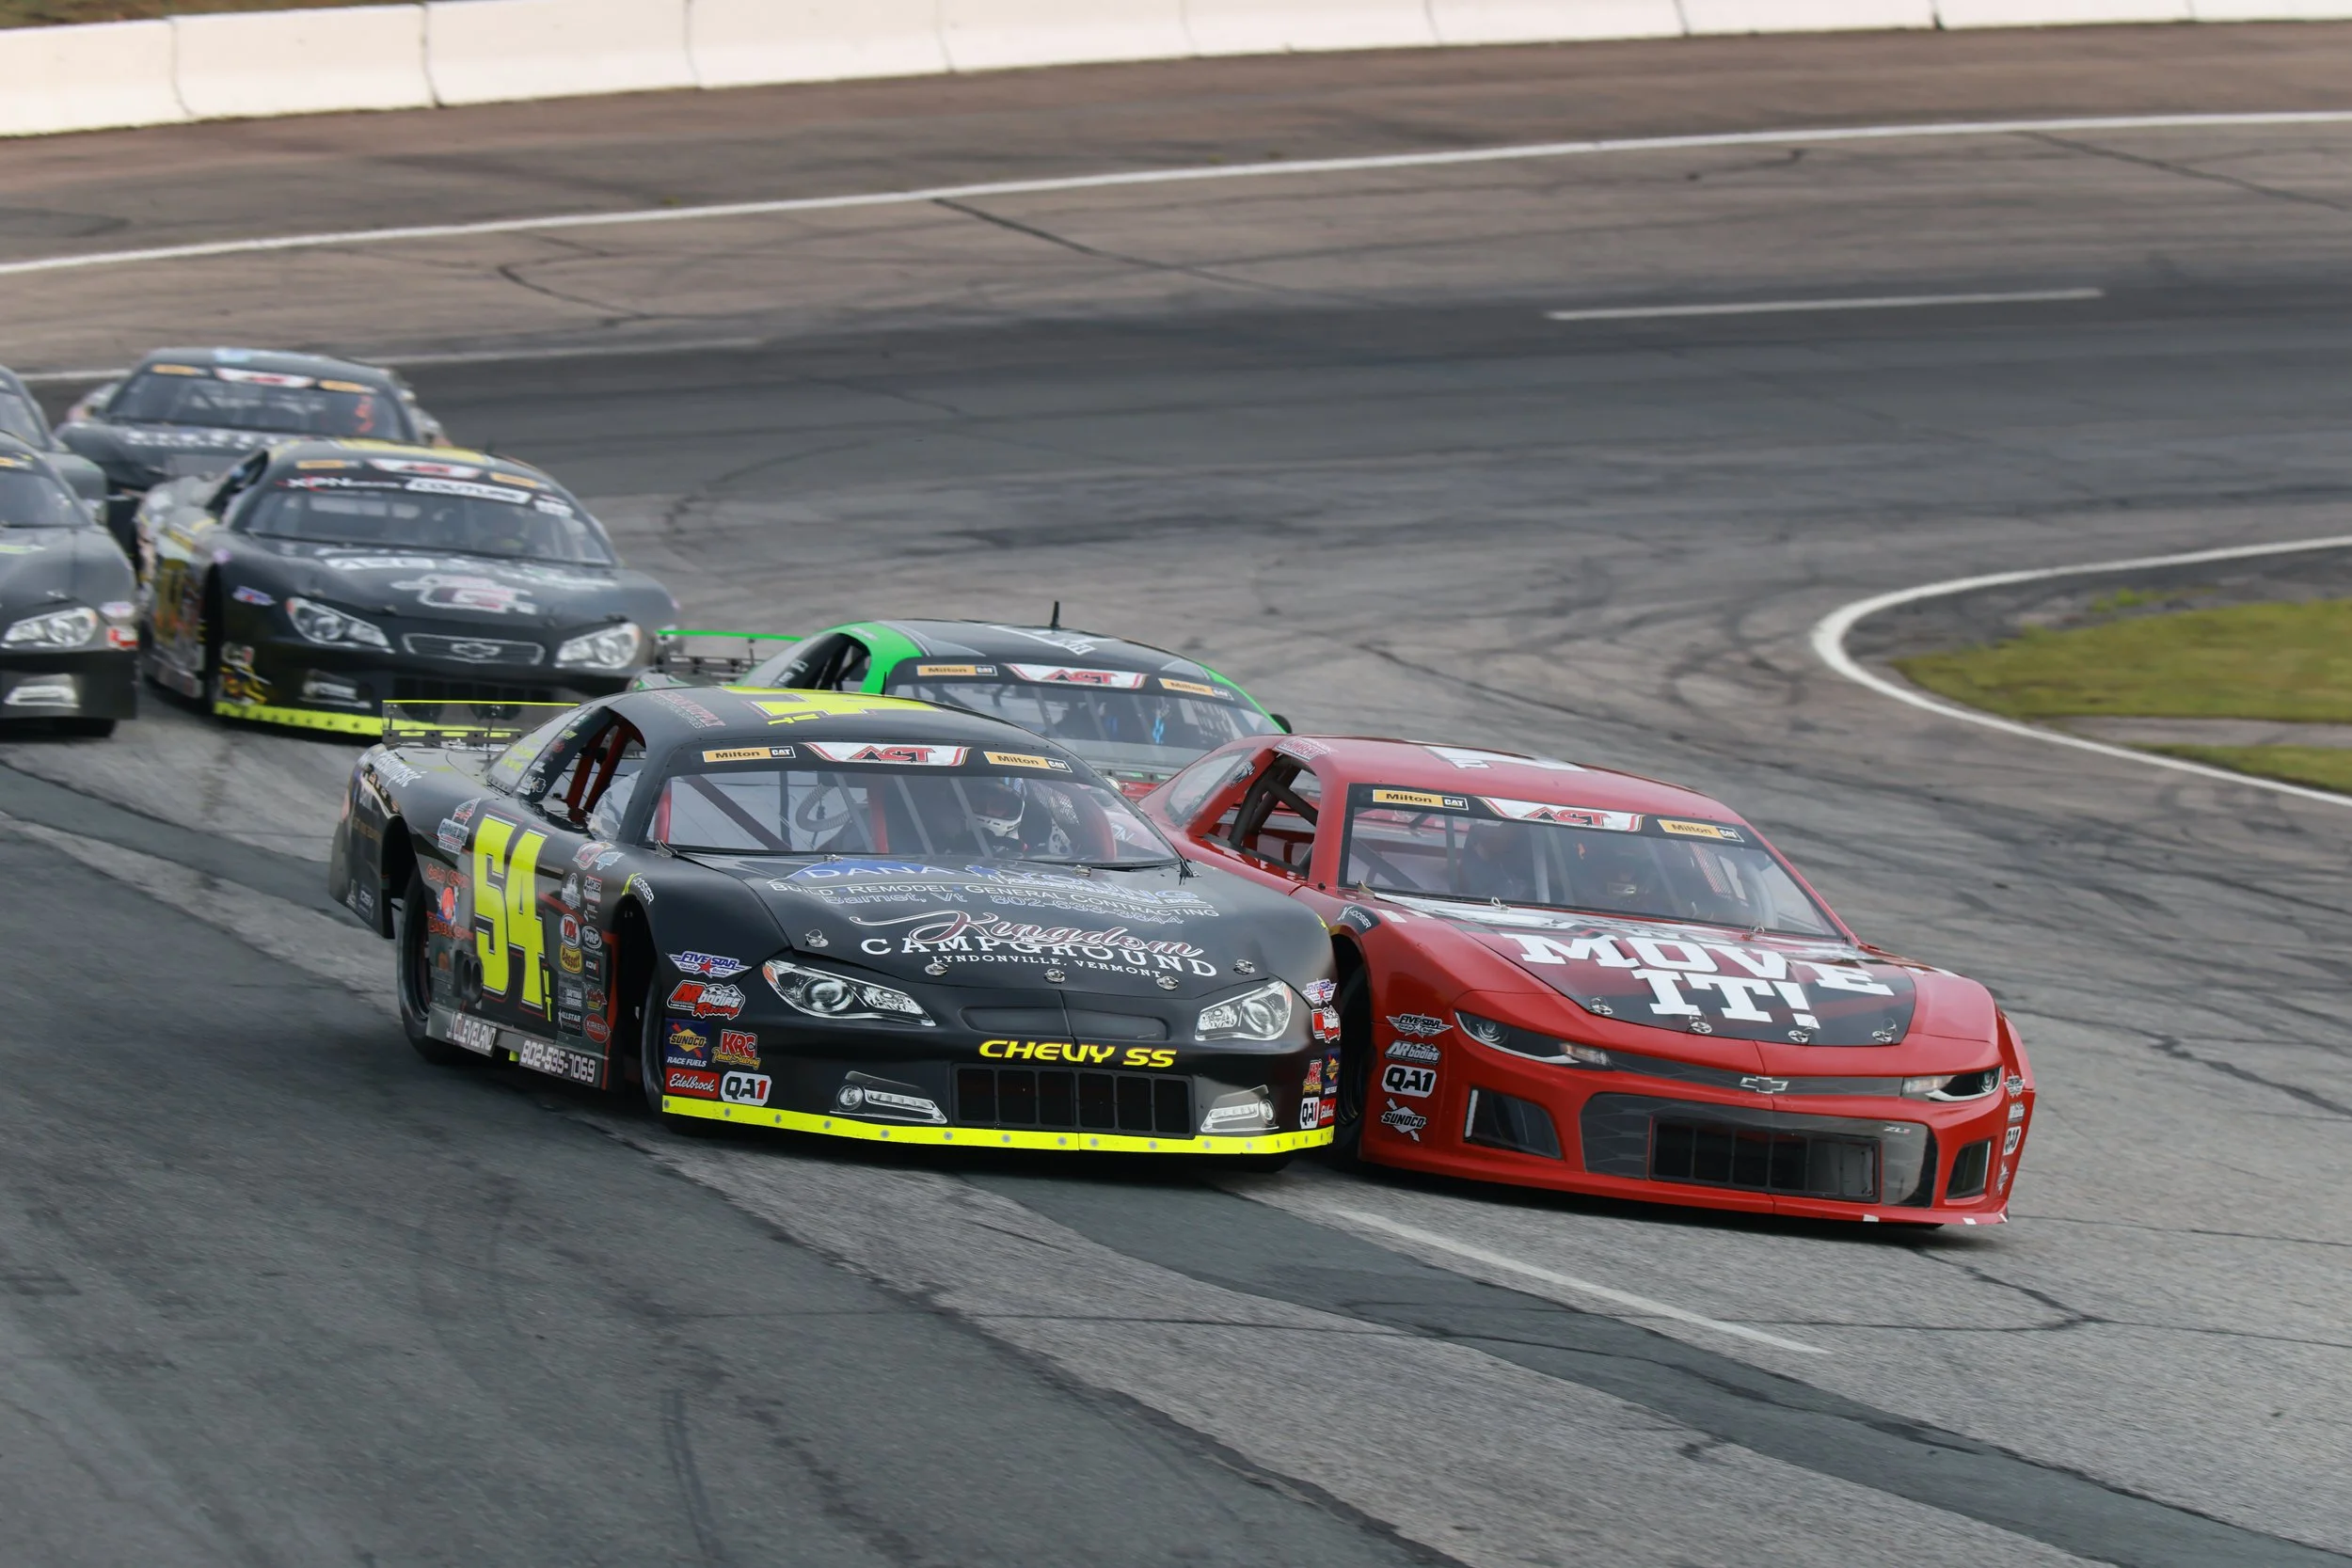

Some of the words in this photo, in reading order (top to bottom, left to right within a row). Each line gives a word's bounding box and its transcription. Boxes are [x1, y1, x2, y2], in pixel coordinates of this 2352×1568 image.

[928, 666, 967, 674] Milton
[1041, 669, 1118, 685] ACT
[1170, 682, 1206, 693] Milton
[715, 750, 760, 759] Milton
[771, 749, 790, 757] CAT
[847, 745, 936, 763] ACT
[997, 754, 1039, 766] Milton
[1048, 761, 1067, 770] CAT
[1386, 792, 1433, 803] Milton
[1444, 799, 1464, 808] CAT
[1522, 805, 1613, 827] ACT
[1672, 823, 1712, 835] Milton
[1720, 829, 1739, 839] CAT
[804, 866, 955, 879] DANA
[1024, 872, 1200, 900] YOUNG
[769, 882, 834, 895] BUILD
[848, 884, 953, 895] REMODEL
[963, 885, 1066, 900] GENERAL
[1070, 894, 1220, 917] CONTRACTING
[821, 893, 927, 905] Barnet,
[930, 892, 968, 903] Vt
[474, 814, 548, 1009] 54
[1348, 909, 1372, 929] HOOSIER
[849, 909, 1205, 958] Kingdom
[681, 953, 708, 964] FIVE
[711, 958, 739, 970] STAR
[860, 936, 1218, 977] CAMPGROUND
[1498, 934, 1895, 995] MOVE
[1075, 960, 1163, 979] VERMONT
[697, 990, 742, 1007] bodies
[1631, 969, 1821, 1030] IT!
[693, 1003, 739, 1020] Racing
[1399, 1015, 1422, 1024] FIVE
[1422, 1019, 1440, 1029] STAR
[670, 1035, 706, 1047] SUNOCO
[722, 1032, 756, 1058] KRC
[978, 1039, 1116, 1064] CHEVY
[1122, 1048, 1177, 1068] SS
[1387, 1041, 1411, 1055] AR
[1408, 1045, 1439, 1061] bodies
[667, 1056, 686, 1066] RACE
[687, 1058, 707, 1068] FUELS
[669, 1073, 716, 1092] Edelbrock
[724, 1076, 769, 1101] QA1
[1386, 1068, 1434, 1092] QA1
[1302, 1101, 1318, 1126] QA1
[1383, 1112, 1425, 1128] SUNOCO
